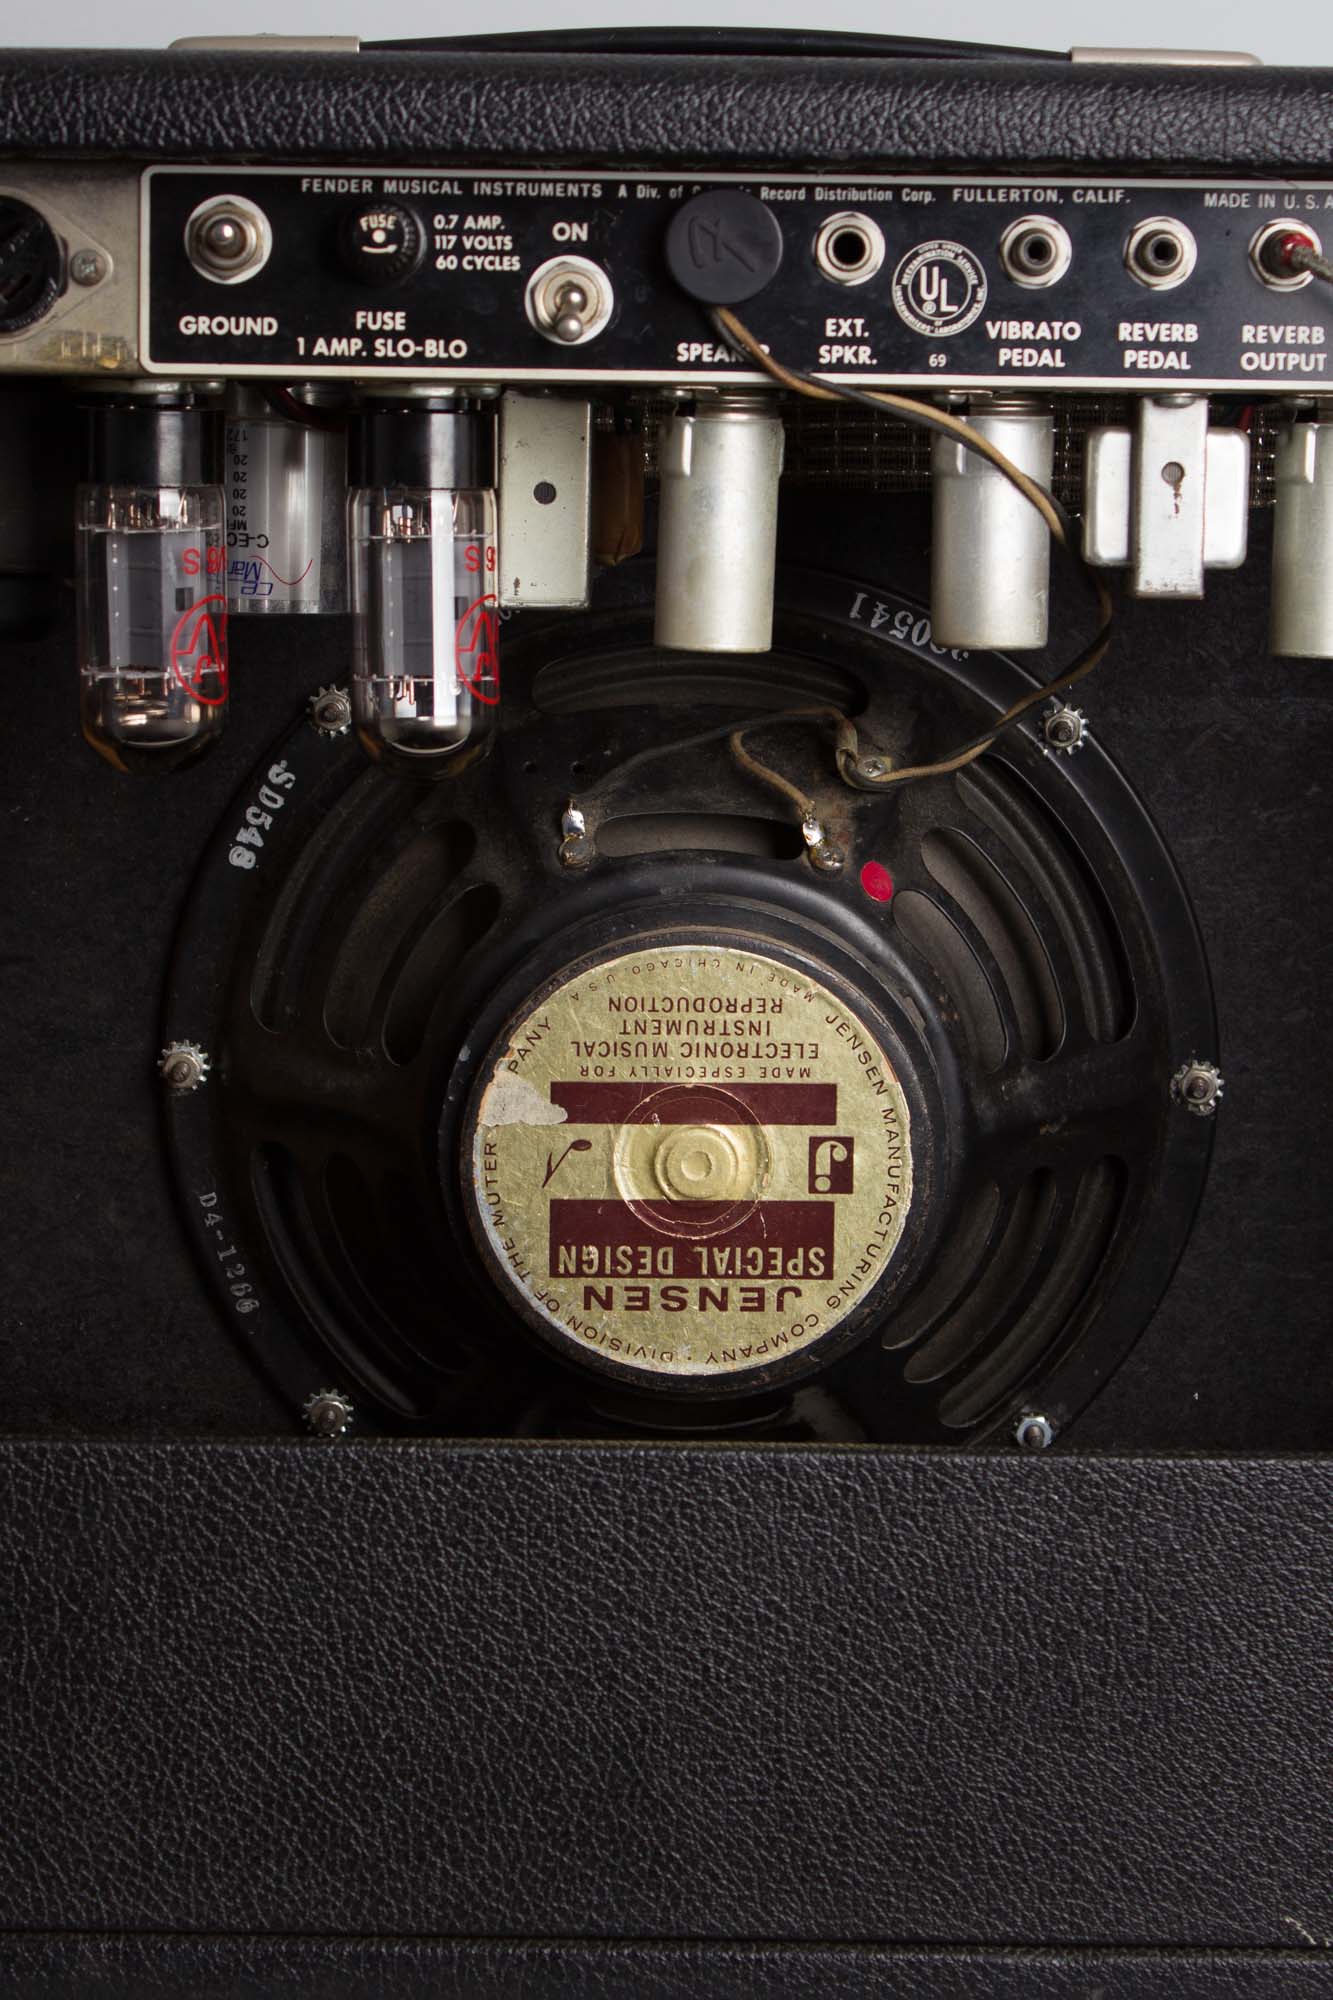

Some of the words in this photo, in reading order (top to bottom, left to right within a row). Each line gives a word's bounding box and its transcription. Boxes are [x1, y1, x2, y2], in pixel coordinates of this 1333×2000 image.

[302, 178, 374, 194] FENDER
[383, 179, 463, 196] MUSICAL
[473, 181, 602, 198] INSTRUMENTS
[618, 184, 627, 198] A
[636, 184, 661, 199] Div.
[669, 185, 683, 199] of
[760, 186, 806, 201] Record
[815, 187, 893, 202] Distribution
[902, 188, 937, 204] Corp.
[952, 188, 1064, 205] FULLERTON,
[1072, 189, 1132, 205] CALIF.
[1204, 193, 1251, 208] MADE
[1258, 193, 1276, 209] IN
[359, 213, 398, 232] FUSE
[433, 214, 459, 230] 0.7
[464, 215, 505, 231] AMP.
[552, 222, 589, 242] ON
[434, 235, 458, 250] 117
[462, 235, 513, 251] VOLTS
[435, 255, 459, 271] 60
[462, 256, 521, 272] CYCLES
[920, 265, 959, 313] UL
[179, 316, 279, 336] GROUND
[356, 311, 407, 331] FUSE
[825, 318, 870, 338] EXT.
[985, 321, 1082, 341] VIBRATO
[1118, 322, 1199, 343] REVERB
[1241, 325, 1326, 344] REVERB
[297, 337, 306, 356] 1
[312, 338, 368, 357] AMP.
[374, 338, 468, 359] SLO-BLO
[676, 342, 770, 362] SPEA
[819, 345, 878, 365] SPKR.
[999, 348, 1066, 368] PEDAL
[928, 354, 948, 368] 69
[1124, 350, 1192, 370] PEDAL
[1240, 352, 1327, 372] OUTPUT
[233, 454, 248, 466] 20
[233, 471, 248, 482] 20
[232, 488, 247, 500] 20
[232, 505, 246, 516] 20
[736, 961, 755, 974] IN
[768, 972, 815, 1003] MADE
[608, 996, 783, 1014] REPRODUCTION
[619, 1019, 770, 1036] INSTRUMENT
[507, 1016, 551, 1075] PANY
[570, 1041, 668, 1058] MUSICAL
[680, 1041, 819, 1059] ELECTRONIC
[825, 1013, 889, 1097] JENSEN
[580, 1065, 616, 1077] FOR
[629, 1066, 745, 1078] ESPECIALLY
[760, 1067, 811, 1078] MADE
[483, 1142, 506, 1227] MUTER
[826, 1107, 901, 1310] MANUFACTURING
[503, 1237, 531, 1283] THE
[558, 1244, 674, 1276] DESIGN
[693, 1246, 826, 1276] SPECIAL
[534, 1290, 561, 1313] OF
[583, 1285, 803, 1313] JENSEN
[566, 1314, 674, 1363] DIVISION
[705, 1313, 820, 1365] COMPANY
